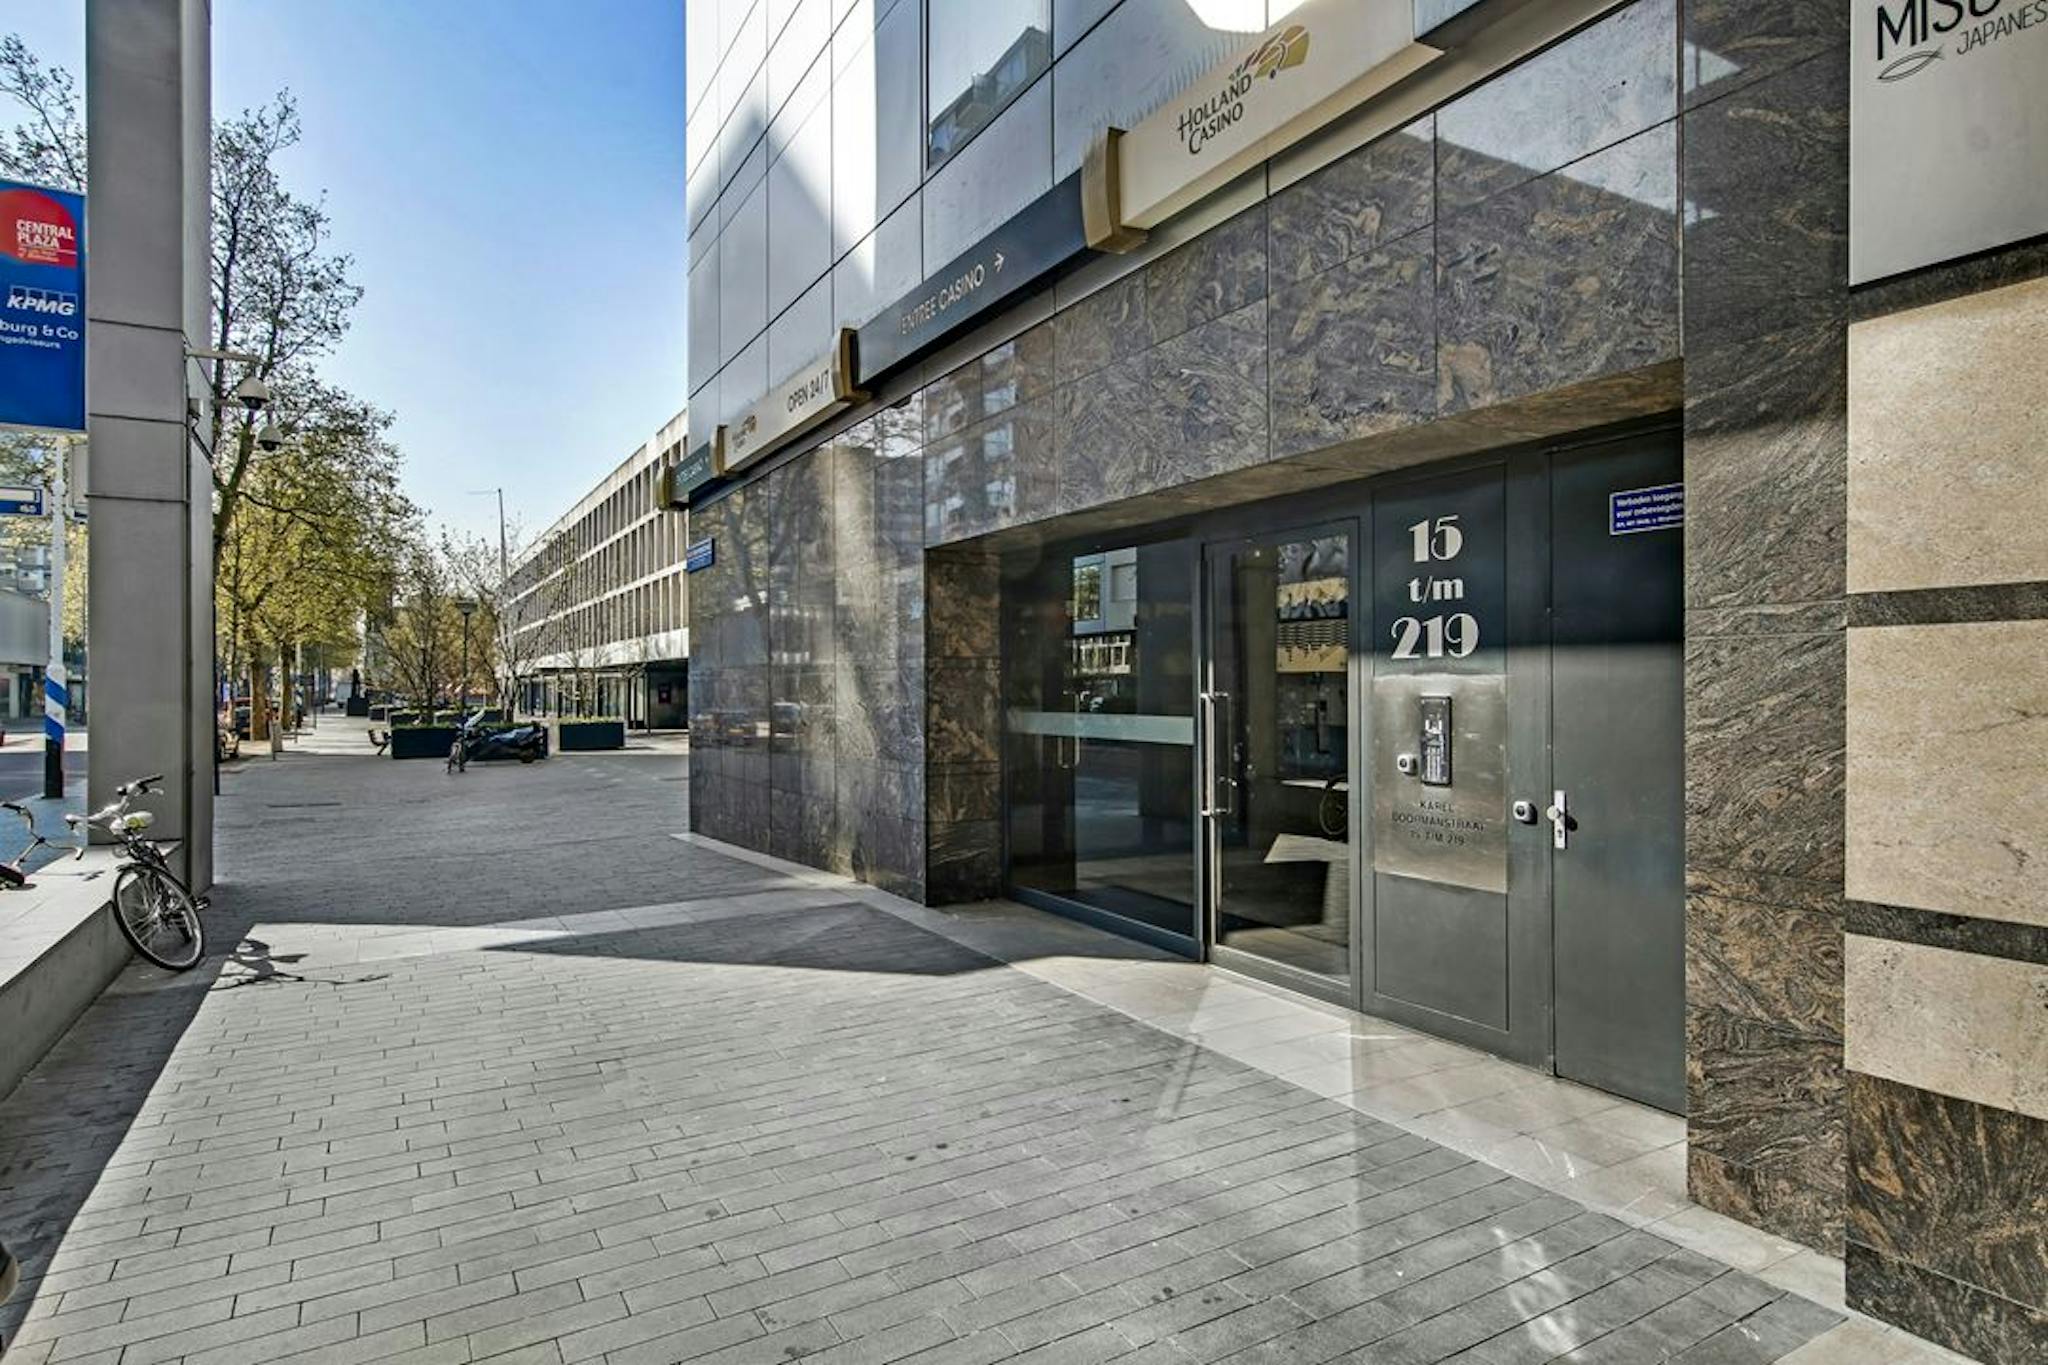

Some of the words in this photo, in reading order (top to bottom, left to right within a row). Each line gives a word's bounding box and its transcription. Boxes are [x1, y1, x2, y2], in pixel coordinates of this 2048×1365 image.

[1956, 1, 2048, 55] JAPANES
[1177, 74, 1252, 141] HOLLAND
[1189, 102, 1244, 154] CASINO
[16, 219, 74, 240] CENTRAL
[17, 231, 59, 248] PLAZA
[7, 294, 75, 315] KPMG
[901, 295, 937, 335] ENTREE
[938, 264, 984, 311] CASINO
[42, 324, 54, 336] &
[56, 326, 79, 340] Co
[787, 386, 809, 413] OPEN
[809, 368, 830, 399] 24/7
[1408, 514, 1463, 562] 15
[1408, 576, 1463, 603] t/m
[1391, 613, 1479, 660] 219
